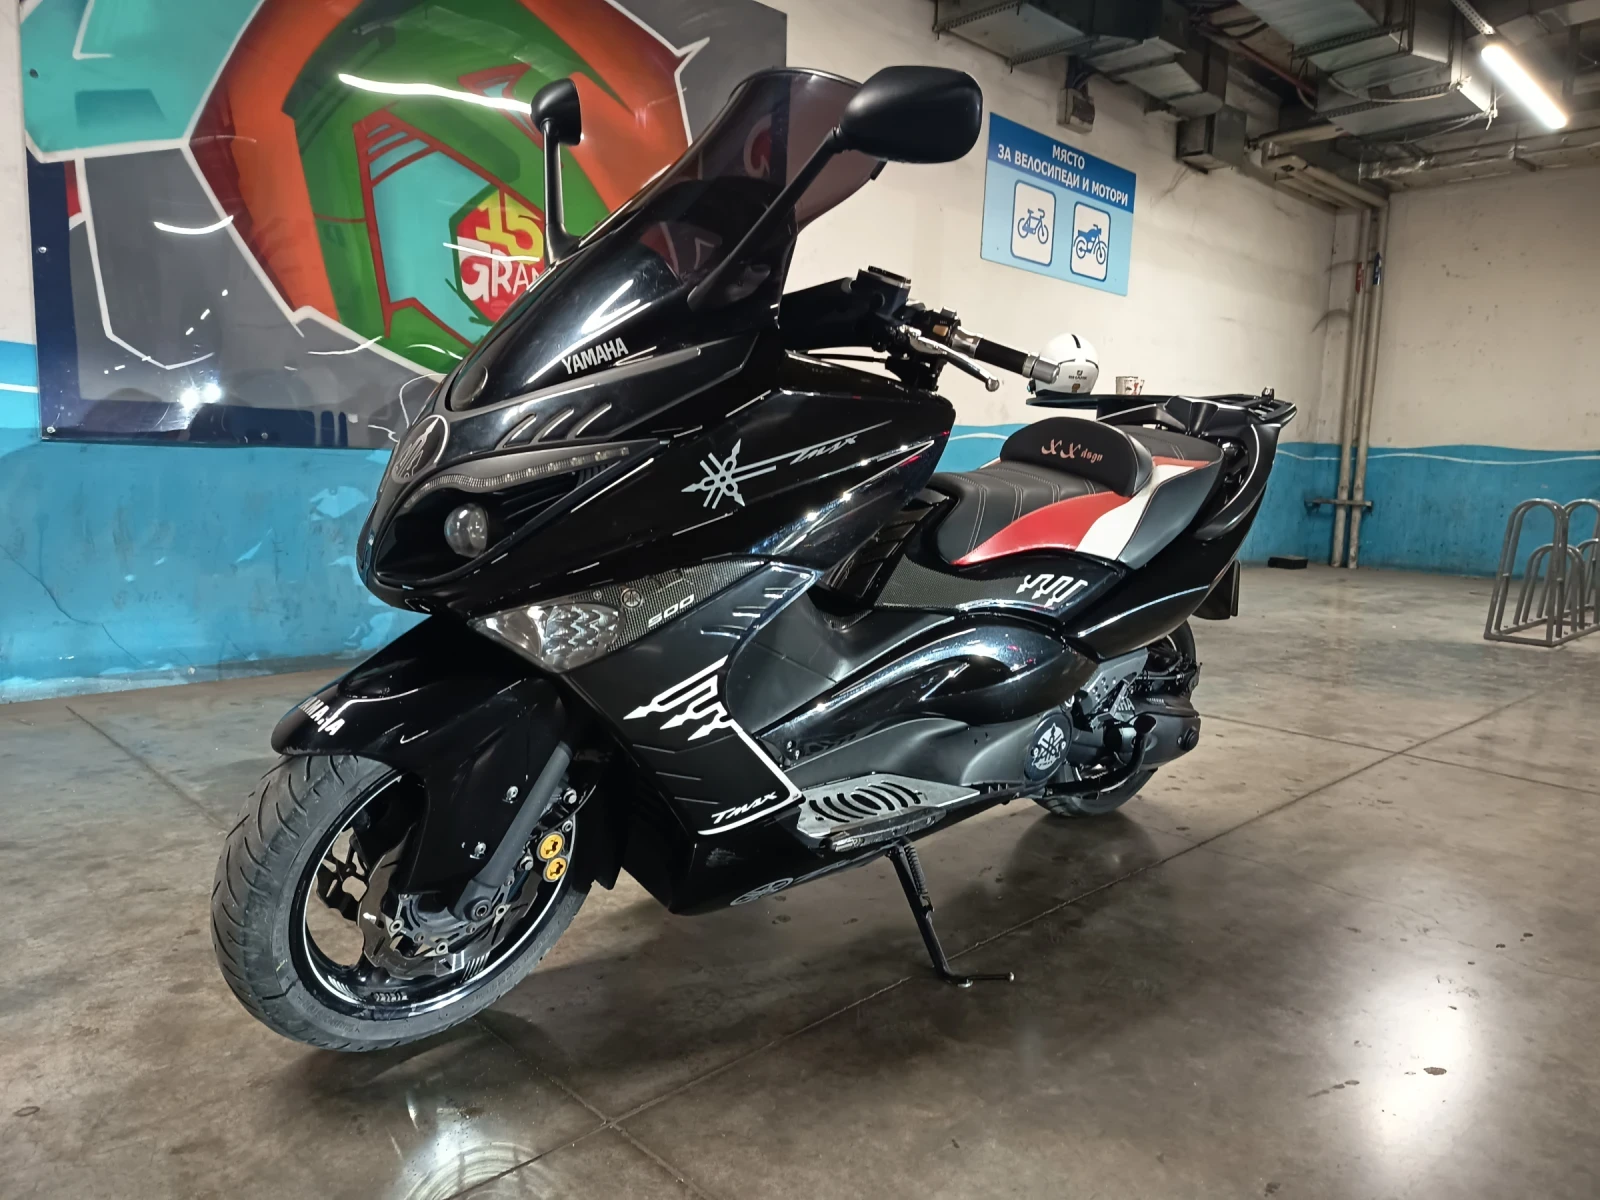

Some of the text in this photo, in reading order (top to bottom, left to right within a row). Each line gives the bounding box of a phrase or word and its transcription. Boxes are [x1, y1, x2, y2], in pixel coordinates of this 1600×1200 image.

[997, 143, 1129, 207] ЗА ВЕЛОСИПЕДИ И МОТОРИ
[1052, 144, 1085, 170] МЯСТО
[475, 190, 544, 265] 15
[561, 337, 629, 375] YAMAHA
[648, 593, 694, 628] 500
